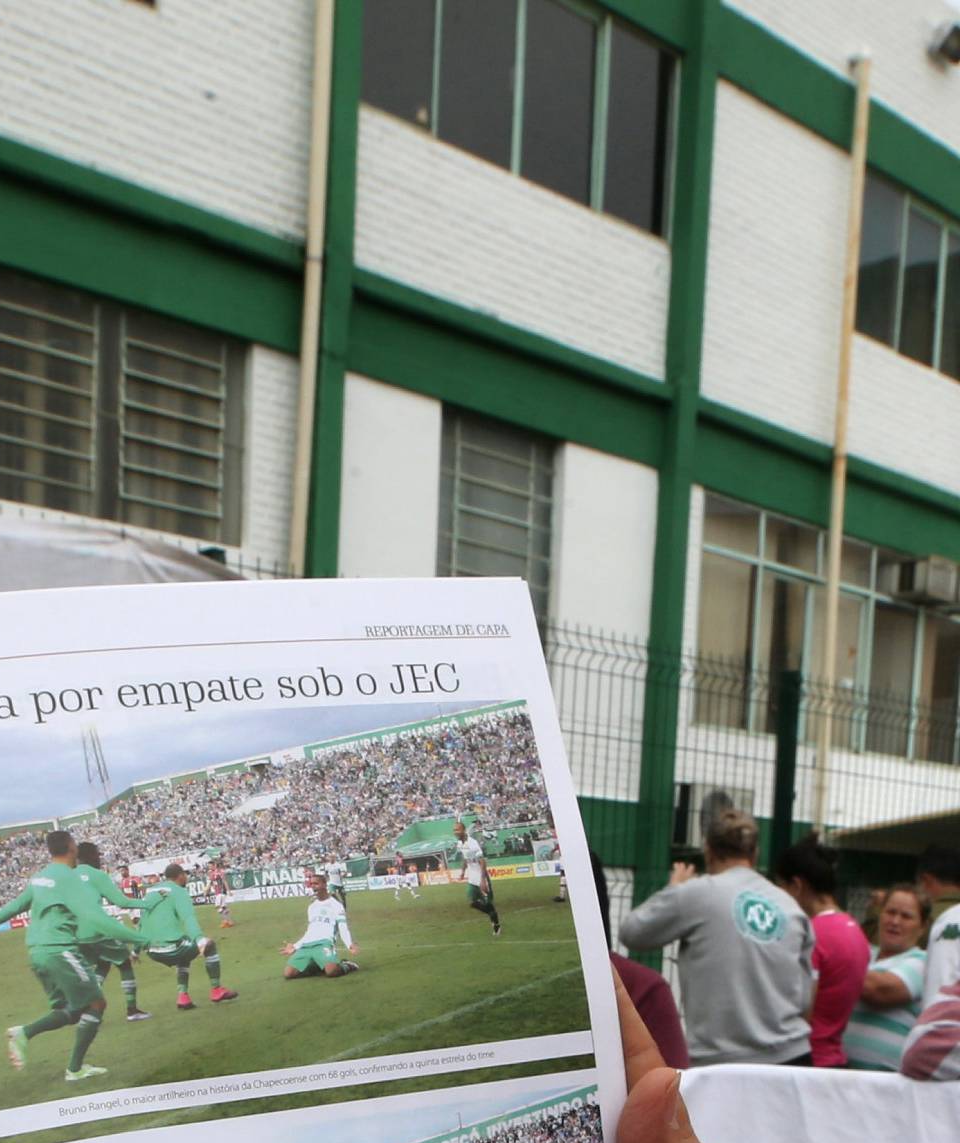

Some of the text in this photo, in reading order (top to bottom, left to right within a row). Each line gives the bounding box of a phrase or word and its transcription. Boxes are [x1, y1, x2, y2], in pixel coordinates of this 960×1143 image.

[365, 624, 509, 637] REPORTAGEM DE CAPA
[29, 687, 103, 724] por
[118, 676, 264, 712] empate
[278, 667, 343, 698] sob
[356, 673, 377, 695] o
[389, 662, 461, 695] JEC
